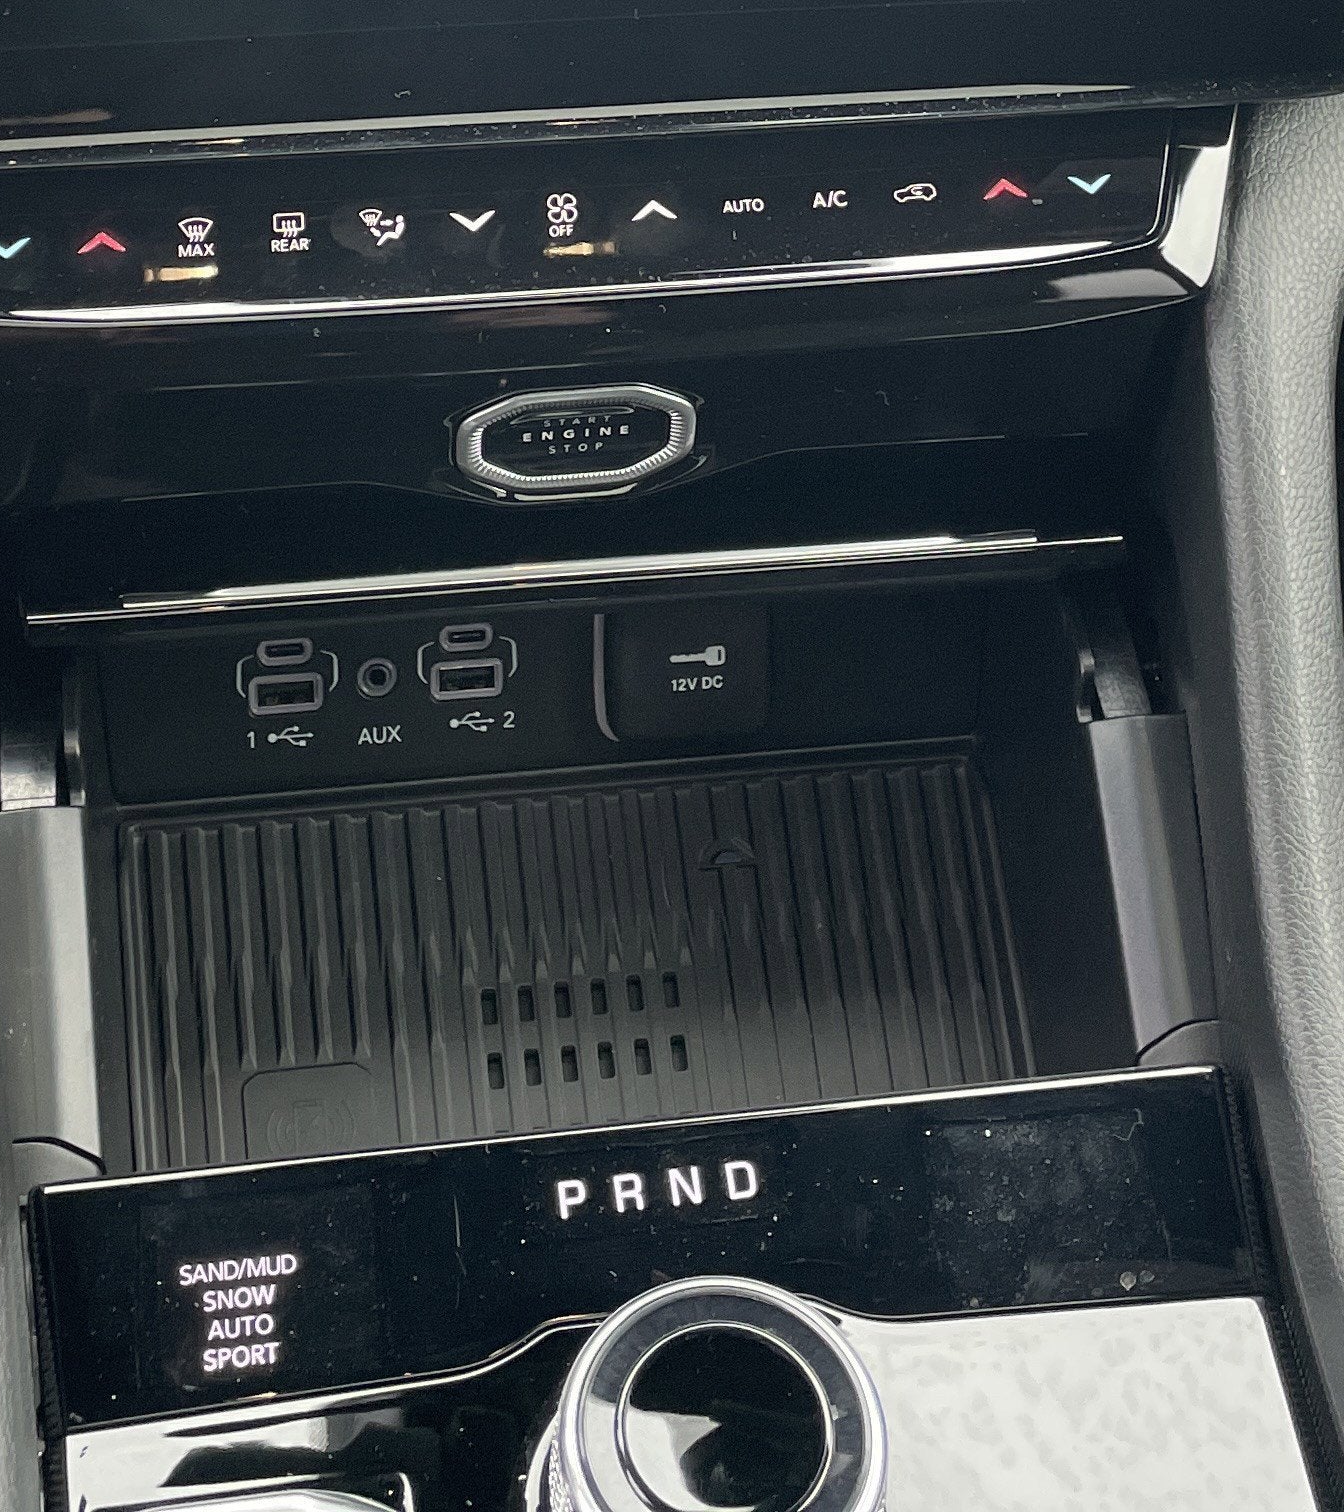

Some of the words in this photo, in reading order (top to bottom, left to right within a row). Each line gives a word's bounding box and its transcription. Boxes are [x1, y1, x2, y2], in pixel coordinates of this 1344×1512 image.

[723, 198, 764, 215] AUTO
[813, 189, 848, 209] A/C
[549, 224, 574, 238] OFF
[178, 243, 215, 258] MAX
[271, 238, 310, 253] REAR
[544, 414, 612, 428] START
[522, 425, 630, 443] ENGINE
[548, 442, 604, 455] STOP
[670, 676, 698, 692] 12V
[701, 675, 724, 690] DC
[504, 711, 516, 730] 2
[247, 731, 256, 748] 1
[358, 724, 402, 746] AUX
[178, 1251, 298, 1286] SAND/MUD
[202, 1284, 276, 1313] SNOW
[207, 1313, 274, 1342] AUTO
[202, 1342, 279, 1372] SPORT
